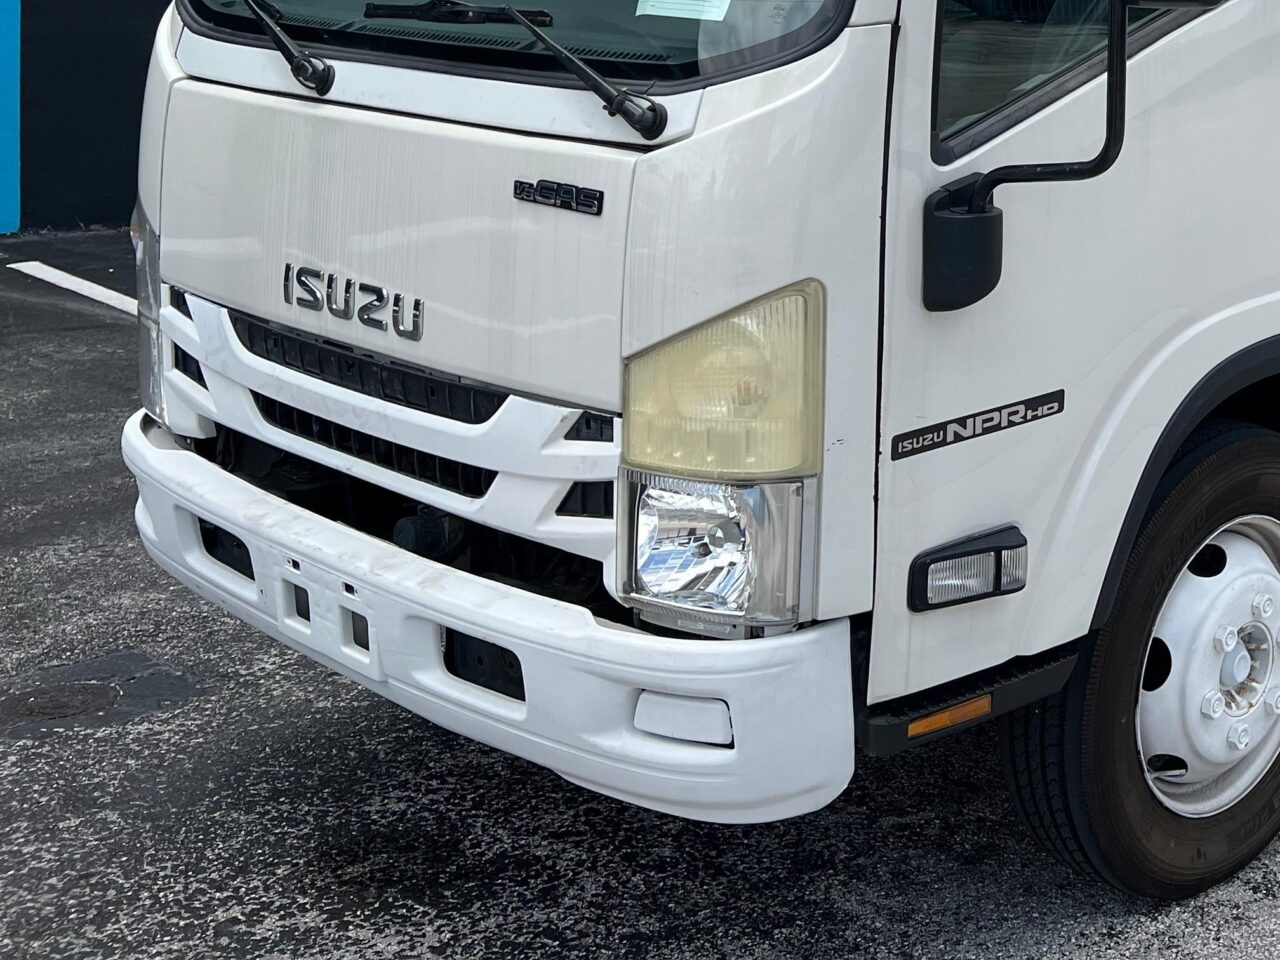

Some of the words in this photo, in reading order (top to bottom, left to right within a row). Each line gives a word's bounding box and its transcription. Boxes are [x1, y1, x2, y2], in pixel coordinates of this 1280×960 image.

[283, 262, 425, 342] ISUZU
[898, 430, 944, 453] ISUZU
[946, 404, 1026, 442] NPR
[1026, 402, 1059, 420] HD
